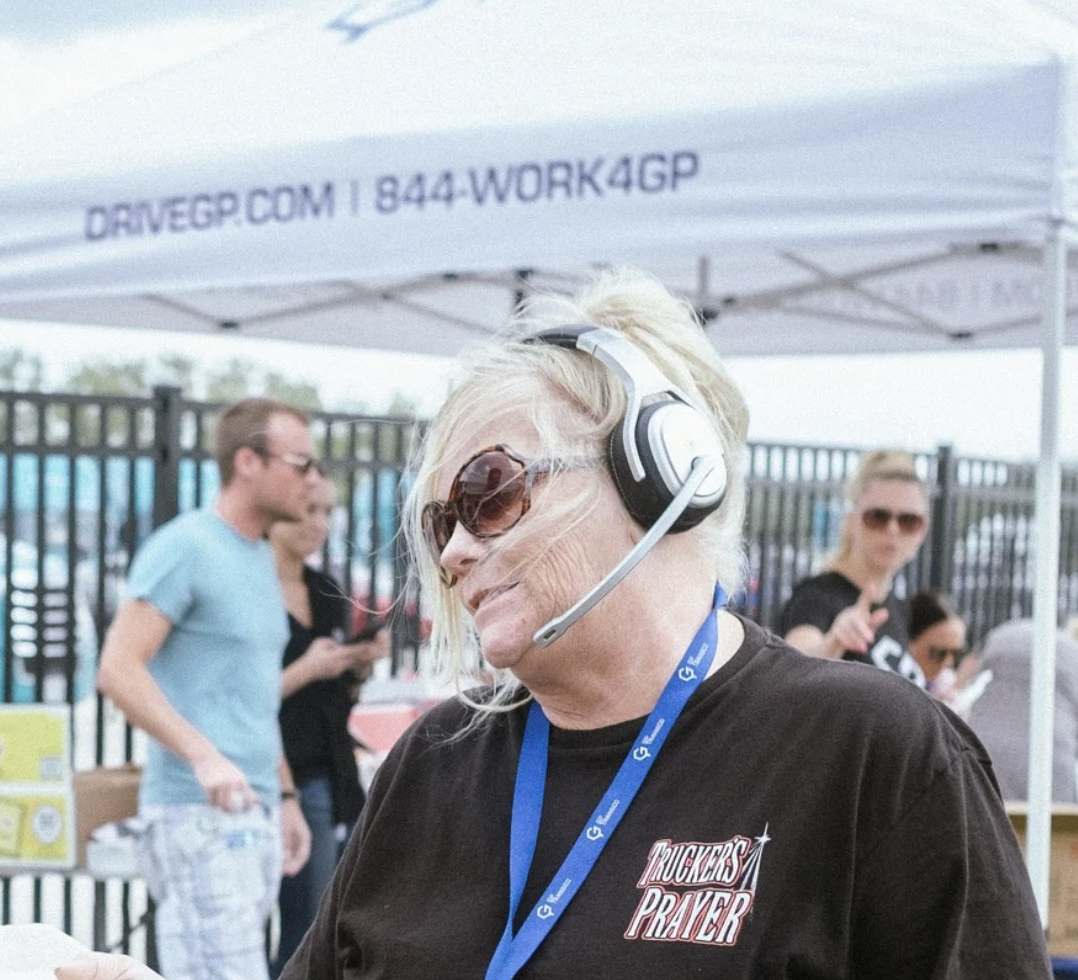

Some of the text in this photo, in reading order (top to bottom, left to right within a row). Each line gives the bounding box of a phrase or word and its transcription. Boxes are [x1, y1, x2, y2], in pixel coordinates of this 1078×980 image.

[84, 150, 700, 242] DRIVEGP.COM 844-WORK4GP
[638, 836, 750, 887] TRUCKER'S
[625, 886, 752, 945] PRAYER
